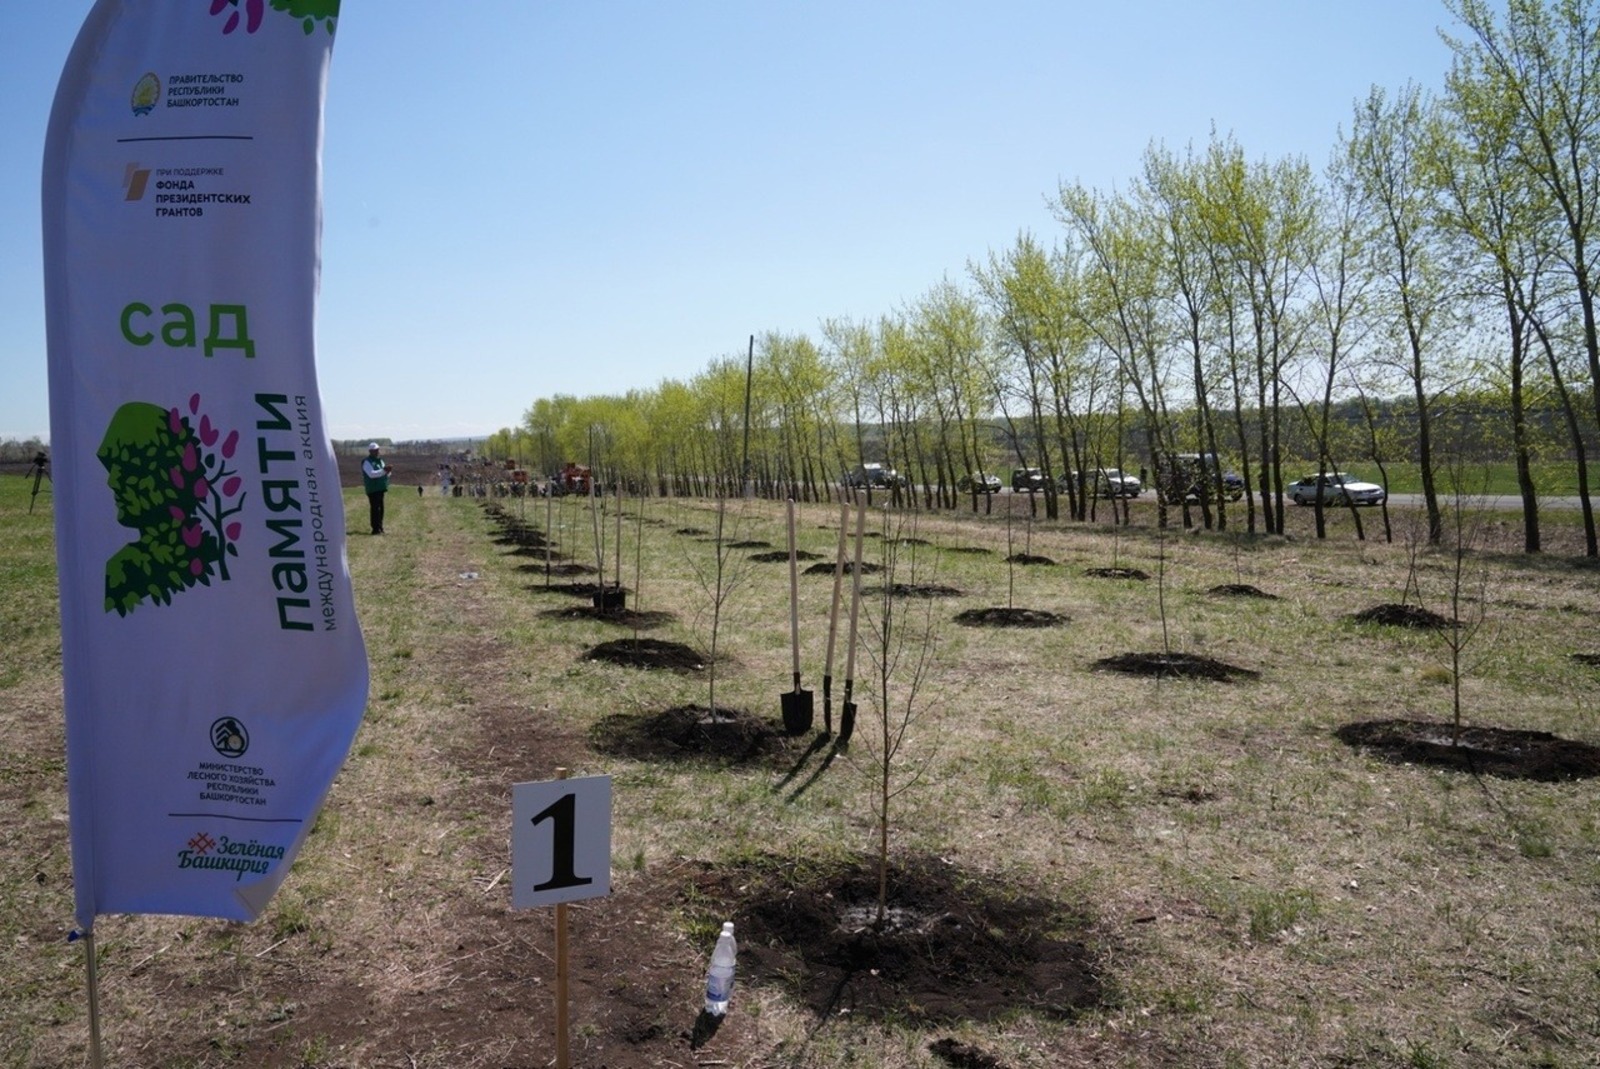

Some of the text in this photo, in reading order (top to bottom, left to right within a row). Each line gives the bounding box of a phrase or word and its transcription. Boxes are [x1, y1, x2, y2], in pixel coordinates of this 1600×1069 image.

[169, 74, 244, 84] ПРАВИТЕЛЬСТВО
[168, 86, 224, 96] РЕСПУБЛИКИ
[167, 98, 239, 108] БАШКОРТОСТАН
[174, 168, 224, 177] ПОДДЕРЖКЕ
[156, 180, 195, 190] ФОНДА
[156, 193, 251, 204] ПРЕЗИДЕНТСКИХ
[156, 207, 203, 217] ГРАНТОВ
[120, 301, 256, 358] сад
[254, 393, 315, 632] памяти
[294, 395, 337, 632] международная акция
[199, 762, 264, 775] МИНИСТЕРСТВО
[187, 771, 276, 787] ЛЕСНОГО ХОЗЯЙСТВА
[207, 782, 259, 795] РЕСПУБЛИКИ
[199, 792, 266, 805] БАШКОРТОСТАН
[217, 836, 285, 860] Зелёная
[530, 793, 593, 892] 1
[178, 850, 270, 882] Башкирия
